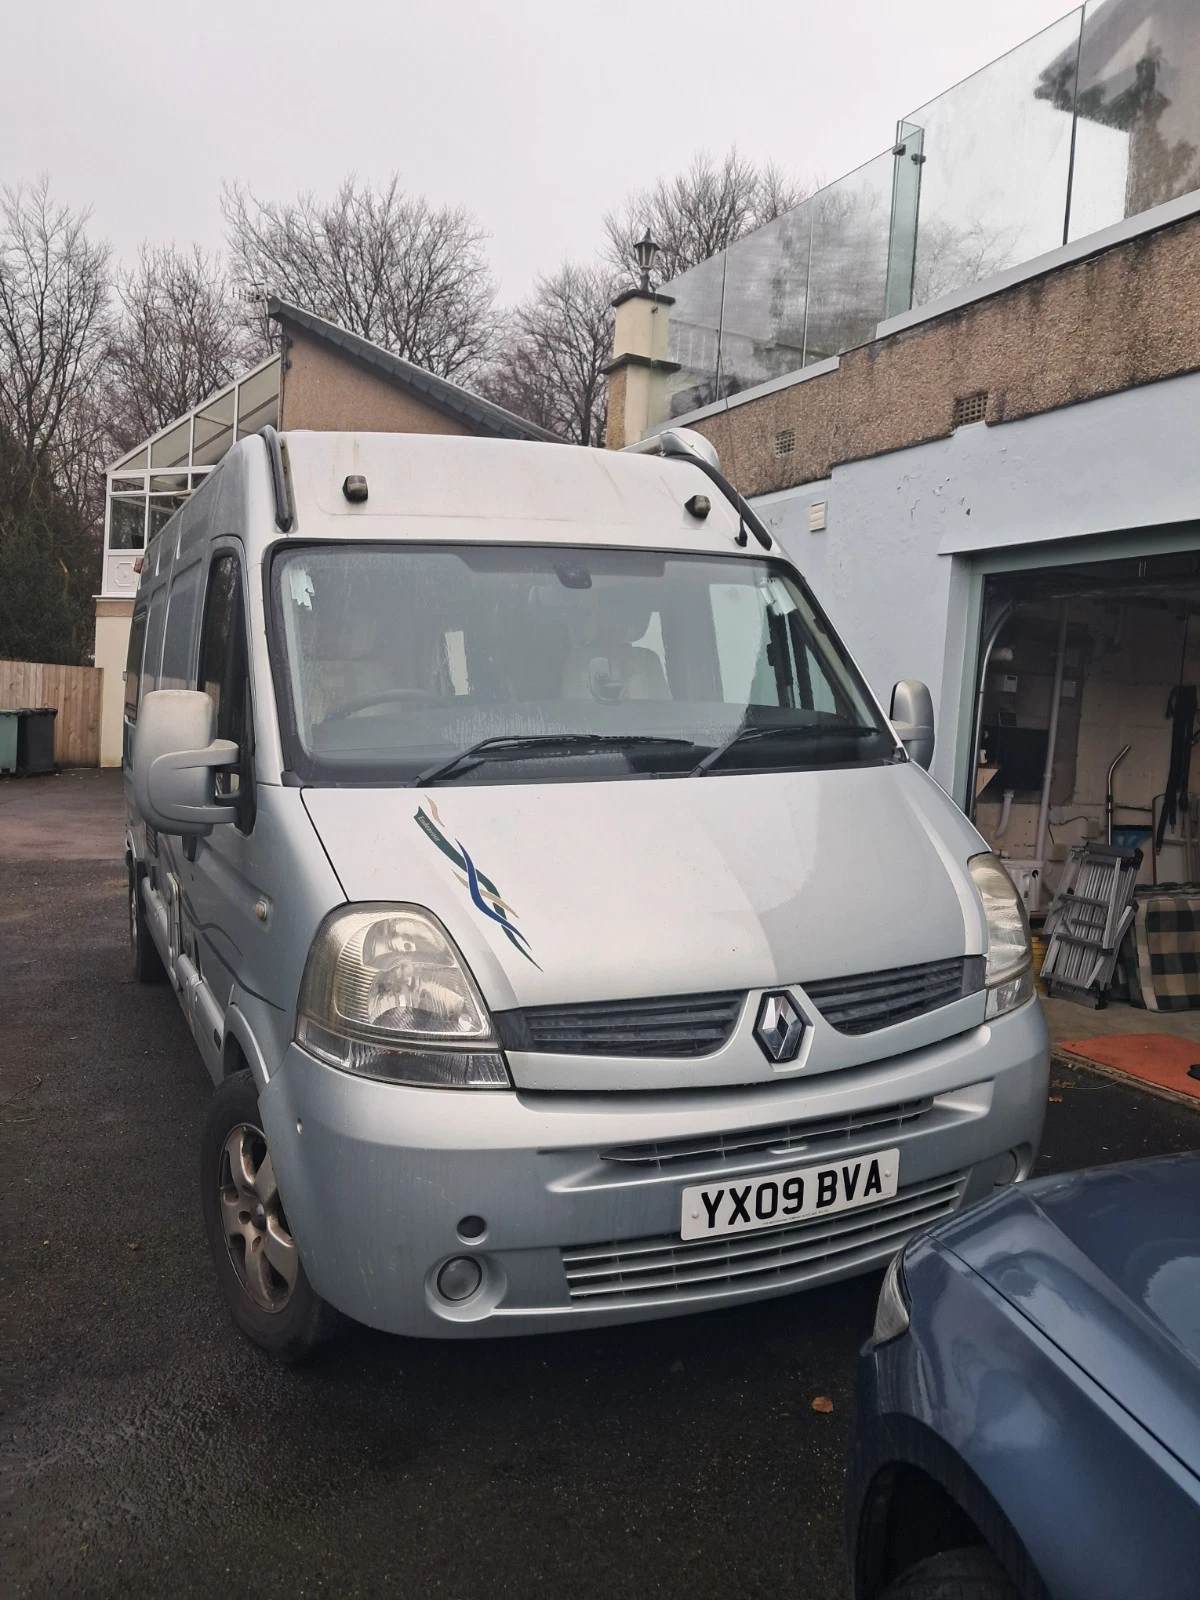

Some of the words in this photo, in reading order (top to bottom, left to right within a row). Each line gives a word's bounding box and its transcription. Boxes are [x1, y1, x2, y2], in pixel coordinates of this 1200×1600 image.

[418, 815, 441, 842] Endeavour
[701, 1176, 805, 1229] YX09
[816, 1159, 882, 1209] BVA
